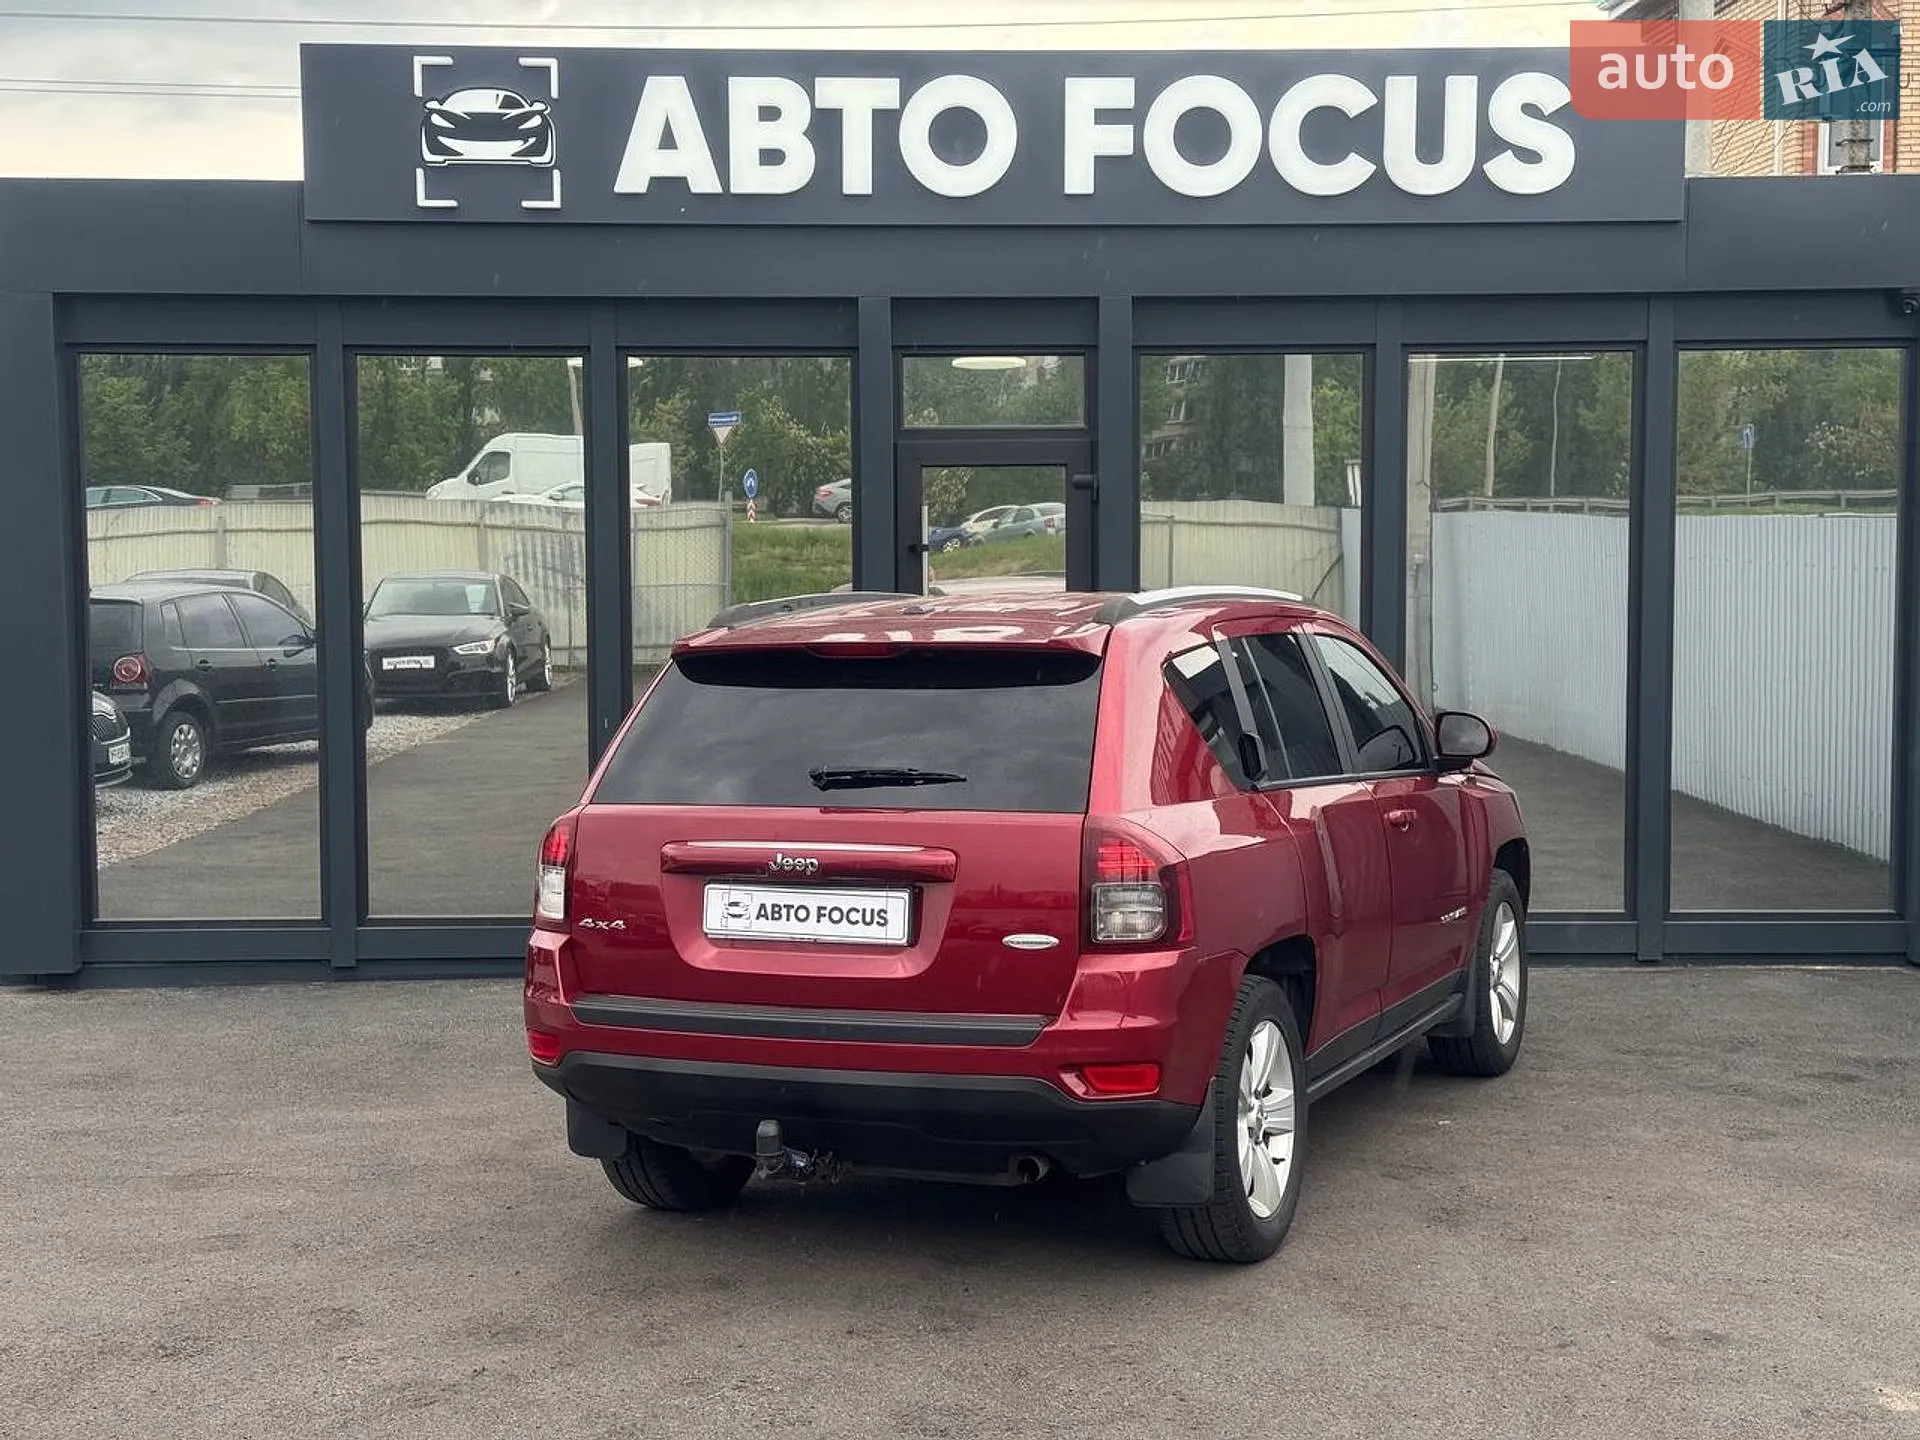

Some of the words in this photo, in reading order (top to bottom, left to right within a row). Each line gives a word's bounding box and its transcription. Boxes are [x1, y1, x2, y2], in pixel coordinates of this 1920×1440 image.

[613, 74, 1018, 198] АВТО
[1064, 72, 1576, 198] FOCUS
[768, 853, 819, 876] Jeep
[578, 917, 627, 930] 4x4
[816, 905, 888, 927] FOCUS
